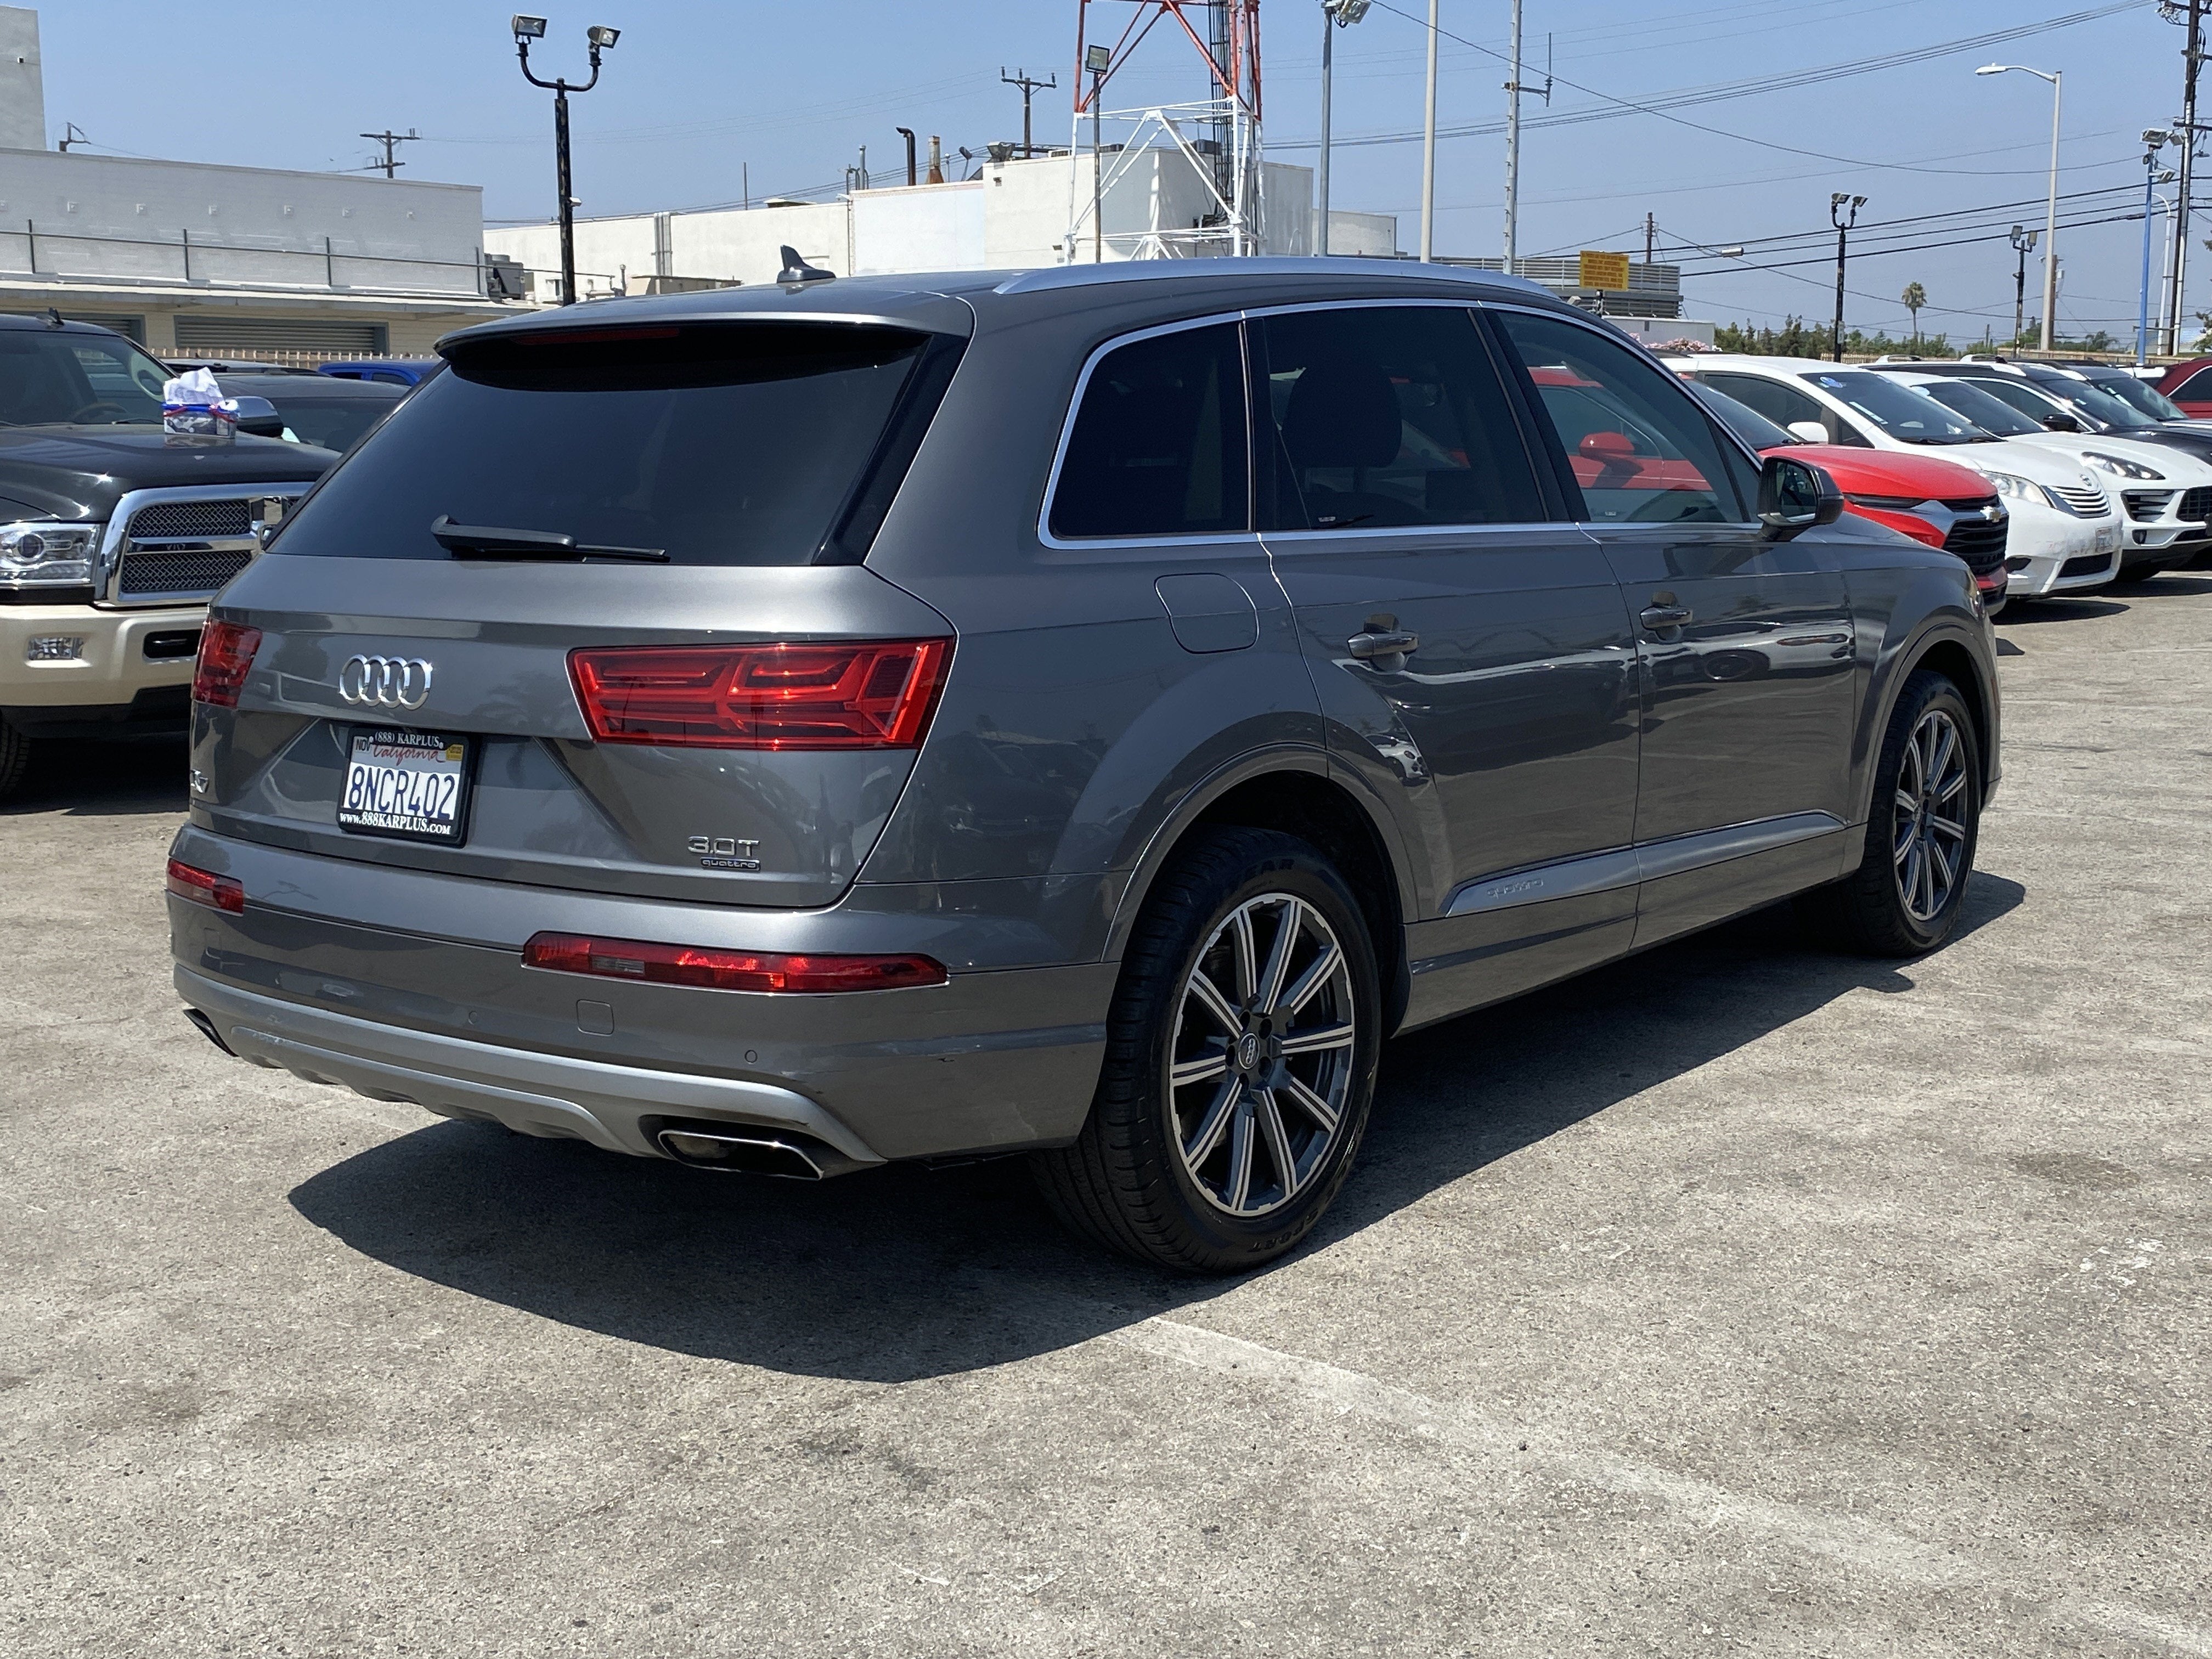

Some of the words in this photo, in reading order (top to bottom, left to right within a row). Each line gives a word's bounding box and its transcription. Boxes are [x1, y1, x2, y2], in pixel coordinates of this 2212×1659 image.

[356, 738, 370, 751] NOV
[375, 731, 394, 743] (888)
[397, 733, 440, 747] KARPLUS
[373, 744, 447, 766] California
[348, 766, 455, 820] 8NCR402
[687, 836, 760, 857] 3.0T
[702, 860, 756, 869] quattro
